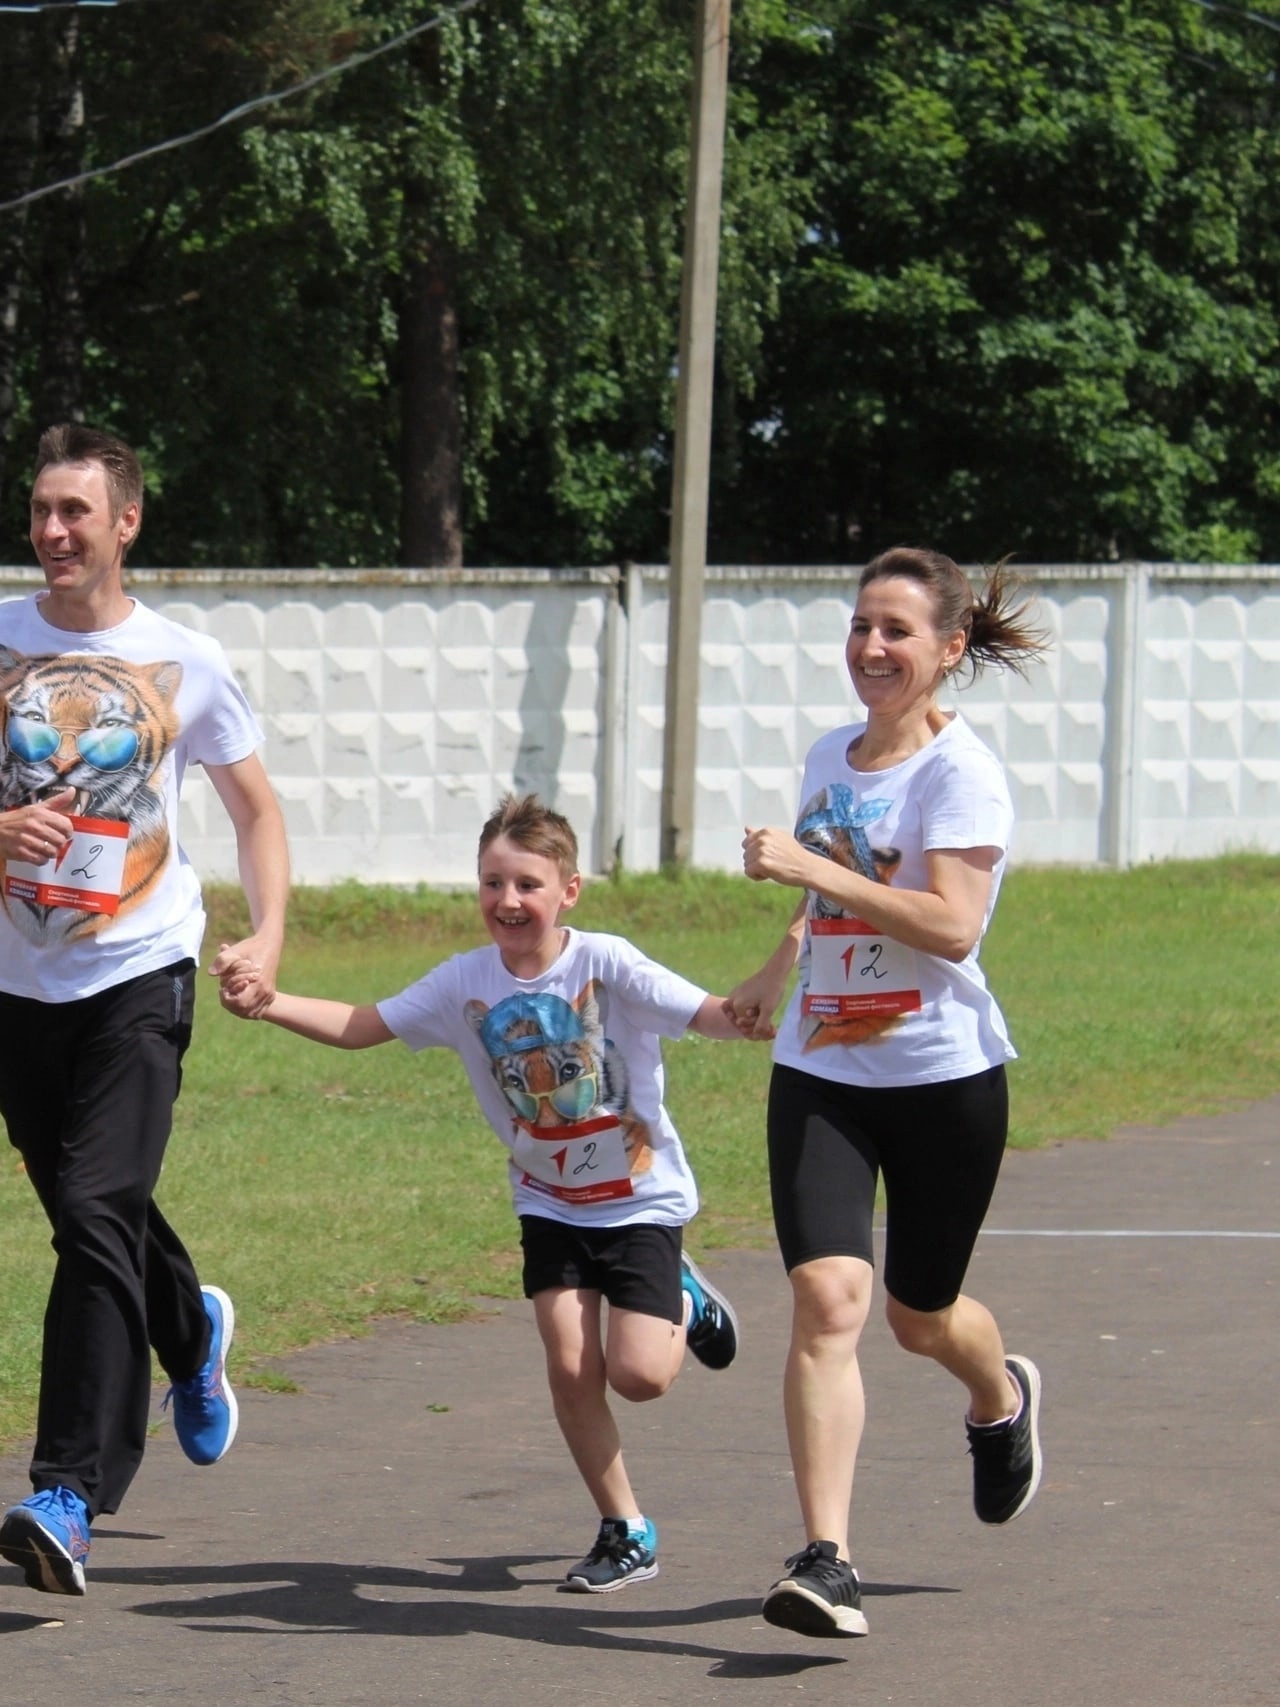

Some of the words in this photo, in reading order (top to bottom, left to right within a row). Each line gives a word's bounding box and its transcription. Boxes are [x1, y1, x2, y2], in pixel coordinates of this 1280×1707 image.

[70, 844, 104, 880] 2
[860, 943, 888, 979] 2
[572, 1142, 599, 1175] 2
